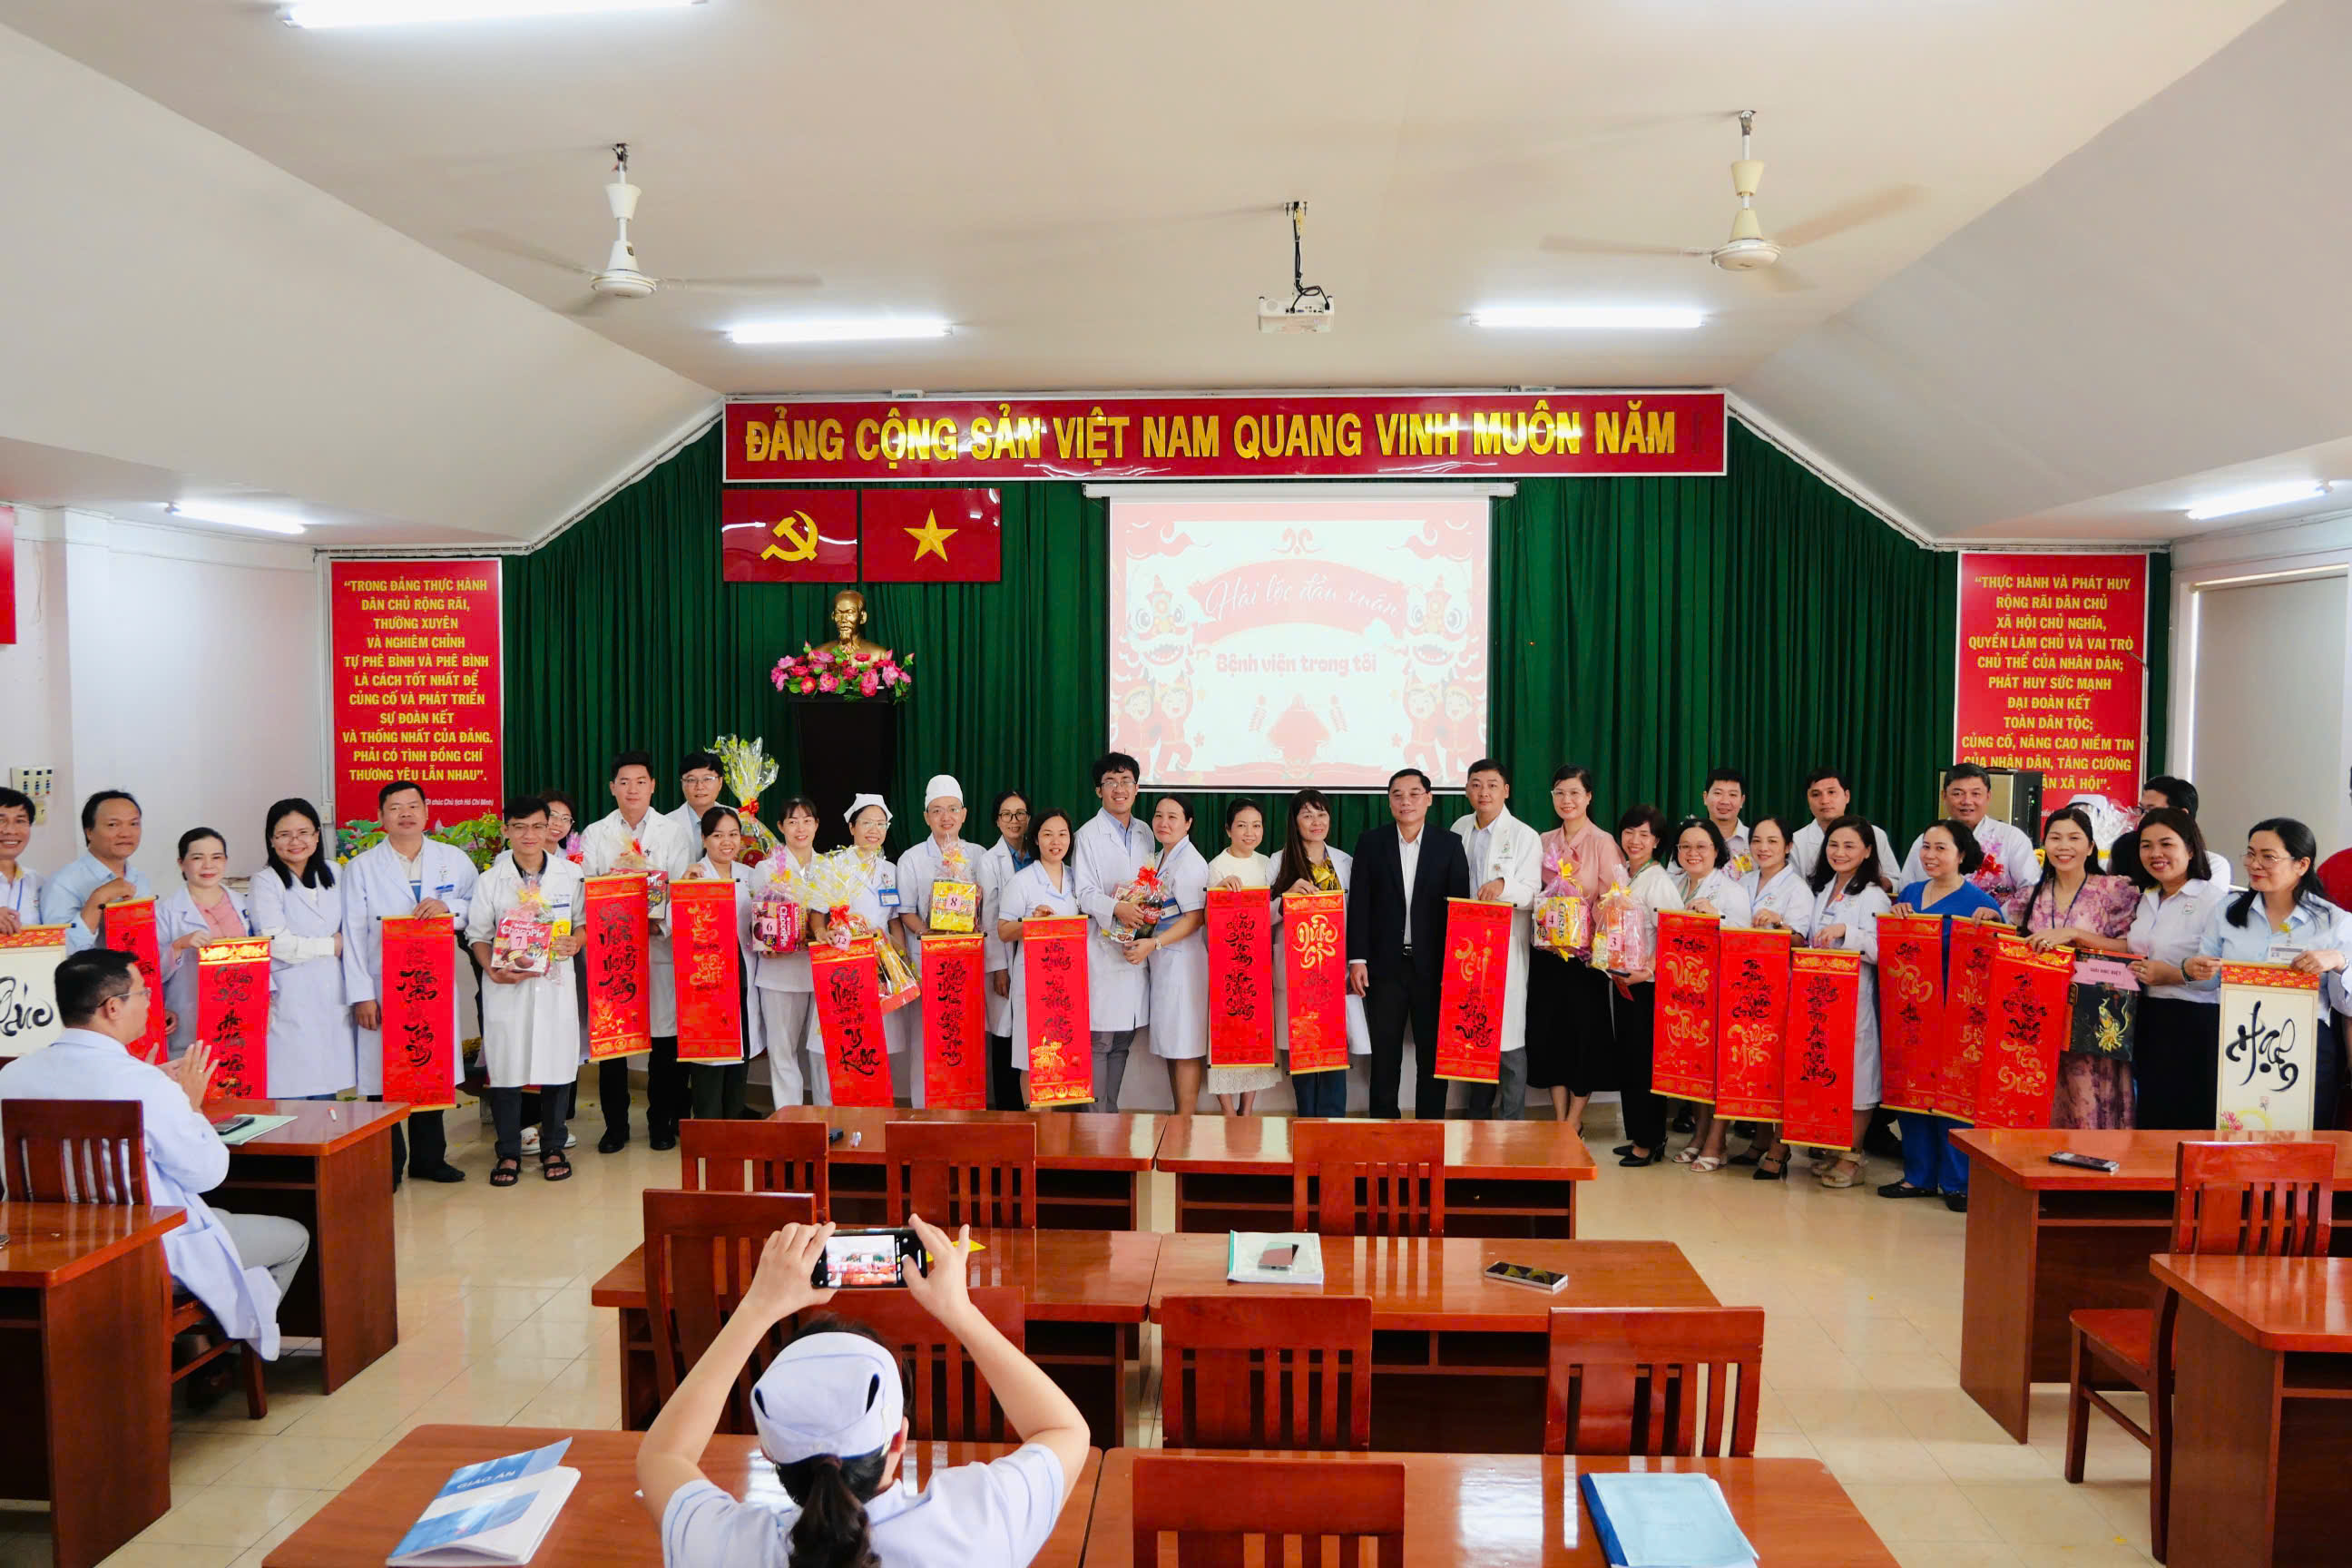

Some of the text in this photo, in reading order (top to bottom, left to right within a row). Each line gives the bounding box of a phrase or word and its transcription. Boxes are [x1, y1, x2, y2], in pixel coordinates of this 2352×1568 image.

[746, 399, 1675, 469] ĐẢNG CỘNG SẢN VIỆT NAM QUANG VINH MUÔN NĂM
[390, 576, 420, 591] ĐẢNG
[424, 578, 453, 592] THỰC
[456, 577, 488, 591] HÀNH
[2017, 574, 2049, 588] HÀNH
[2053, 574, 2067, 588] VÀ
[2073, 575, 2102, 589] PHÁT
[2108, 579, 2130, 590] HUY
[362, 595, 470, 612] DÂN CHỦ RỘNG RÃI,
[1996, 593, 2107, 610] RỘNG RÃI DÂN CHỦ
[374, 616, 458, 629] THƯỜNG XUYÊN
[1996, 613, 2106, 632] XÃ HỘI CHỦ NGHĨA,
[368, 635, 465, 648] VÀ NGHIÊM CHỈNH
[1969, 632, 2133, 652] QUYỀN LÀM CHỦ VÀ VAI TRÒ
[344, 653, 488, 668] TỰ PHÊ BÌNH VÀ PHÊ BÌNH
[1216, 653, 1377, 677] Bệnh viện trong tôi
[1977, 652, 2122, 671] CHỦ THỂ CỦA NHÂN DÂN;
[355, 670, 478, 686] LÀ CÁCH TỐT NHẤT ĐỂ
[1989, 675, 2111, 691] PHÁT HUY SỨC MẠNH
[349, 689, 485, 705] CỦNG CỐ VÀ PHÁT TRIỂN
[2008, 695, 2091, 710] ĐẠI ĐOÀN KẾT
[380, 710, 454, 726] SỰ ĐOÀN KẾT
[2004, 714, 2093, 730] TOÀN DÂN TỘC;
[343, 730, 493, 742] VÀ THỐNG NHẤT CỦA ĐẢNG.
[1962, 731, 1994, 748] CỦNG
[2020, 734, 2052, 749] NÂNG
[2054, 738, 2078, 750] CAO
[2082, 733, 2112, 750] NIỀM
[2115, 739, 2134, 750] TIN
[354, 748, 482, 761] PHẢI CÓ TÌNH ĐỒNG CHÍ
[1991, 756, 2023, 769] NHÂN
[2026, 754, 2053, 770] DÂN,
[2057, 755, 2089, 769] TĂNG
[2092, 756, 2131, 770] CƯỜNG
[349, 768, 394, 780] THƯƠNG
[397, 767, 418, 780] YÊU
[422, 765, 444, 780] LẪN
[2060, 775, 2076, 789] XÃ
[949, 896, 958, 907] 8
[766, 921, 773, 932] 6
[1548, 915, 1554, 925] 4
[515, 936, 523, 946] 7
[836, 936, 848, 946] 12
[1610, 936, 1618, 948] 3
